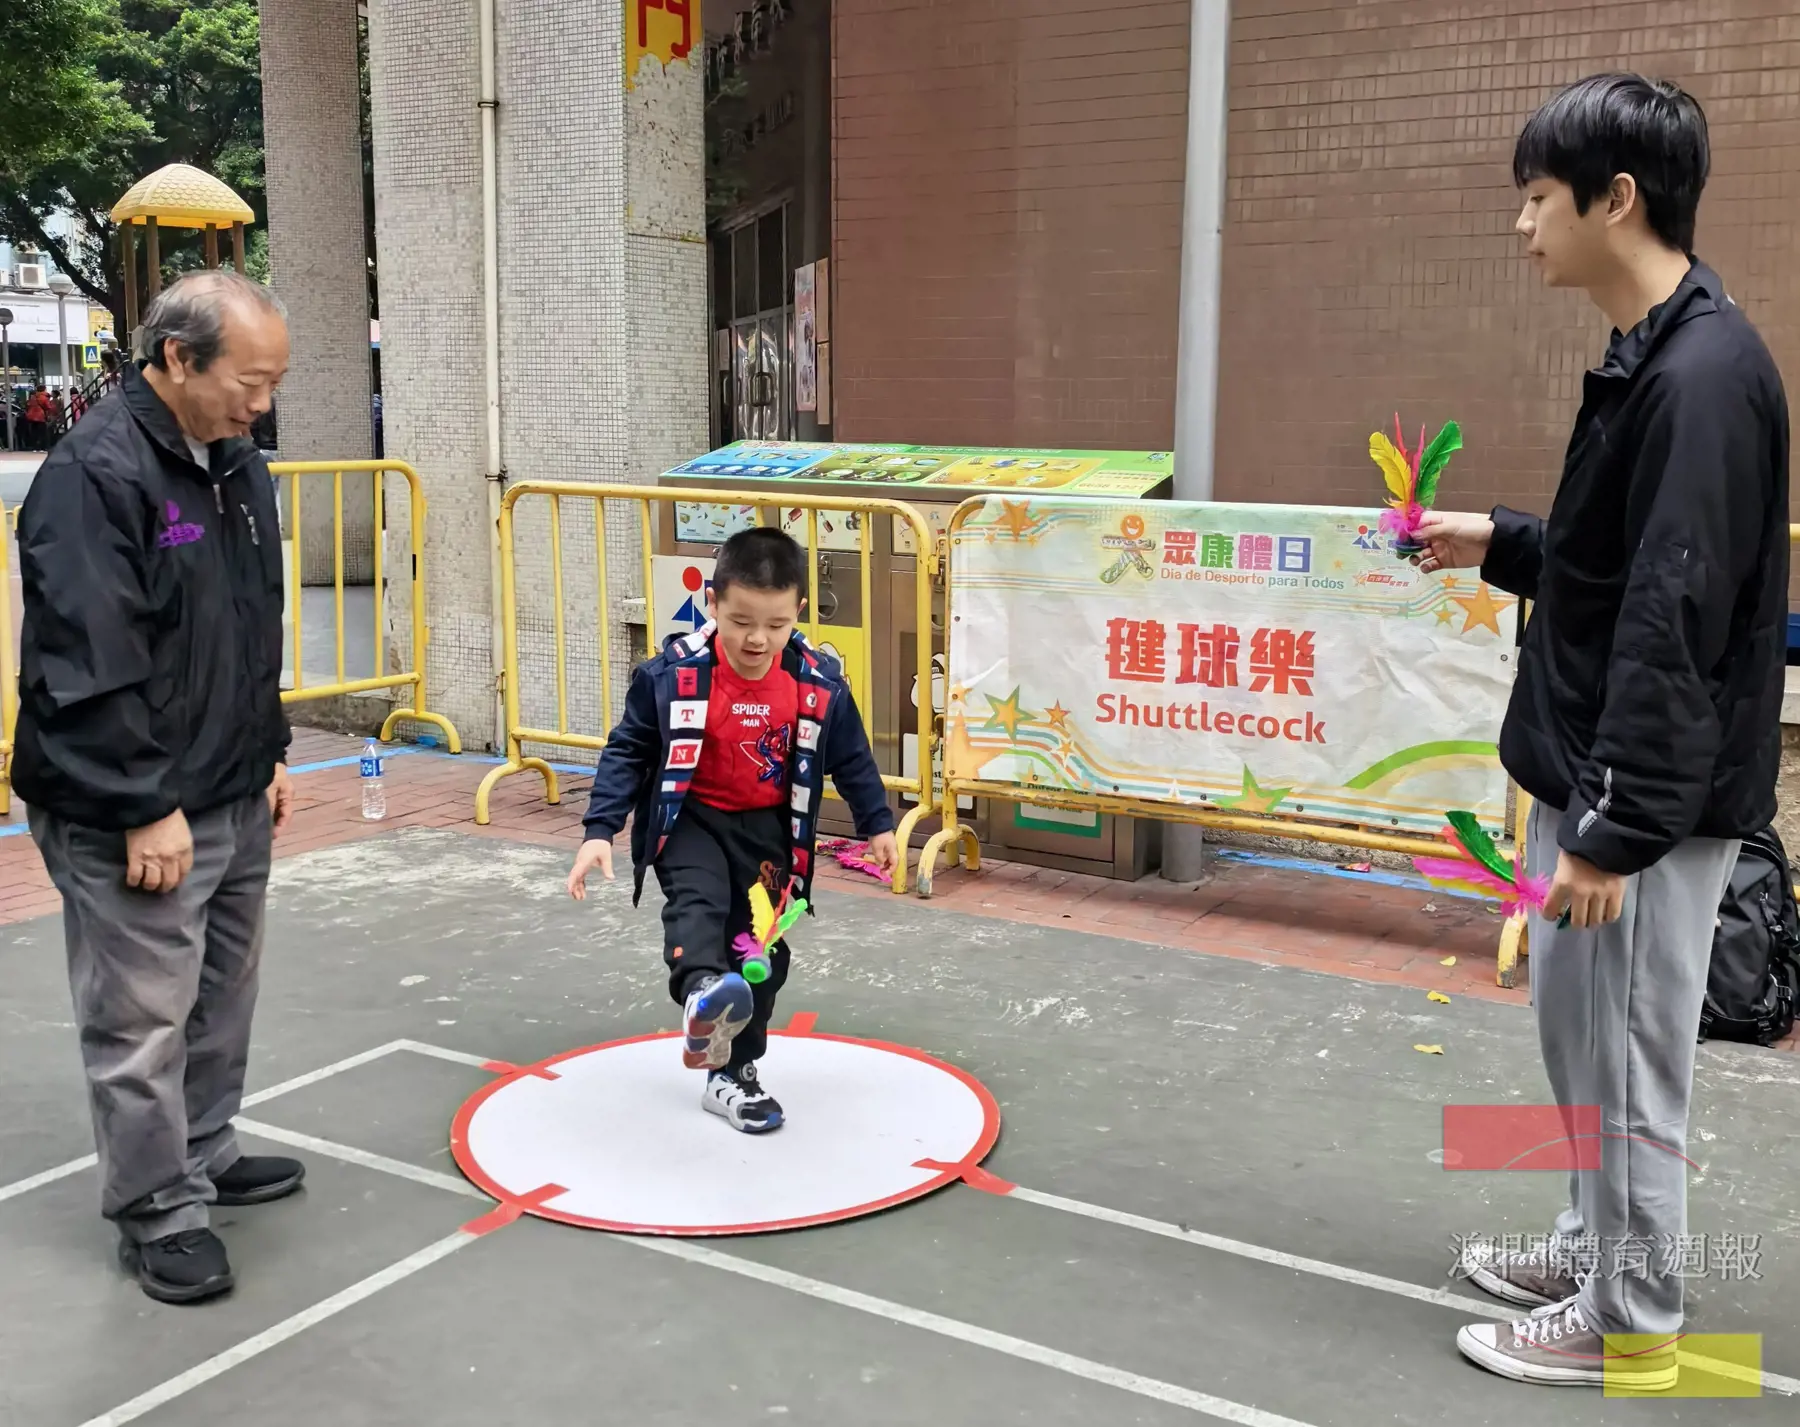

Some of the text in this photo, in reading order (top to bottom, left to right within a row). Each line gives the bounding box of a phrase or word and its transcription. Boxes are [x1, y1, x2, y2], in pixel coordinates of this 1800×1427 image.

[1161, 568, 1345, 590] Dia de Desporto para Todos
[1104, 617, 1317, 697] 毽球樂
[681, 708, 695, 723] T
[731, 703, 771, 717] SPIDER
[1095, 693, 1327, 744] Shuttlecock
[675, 748, 688, 761] N
